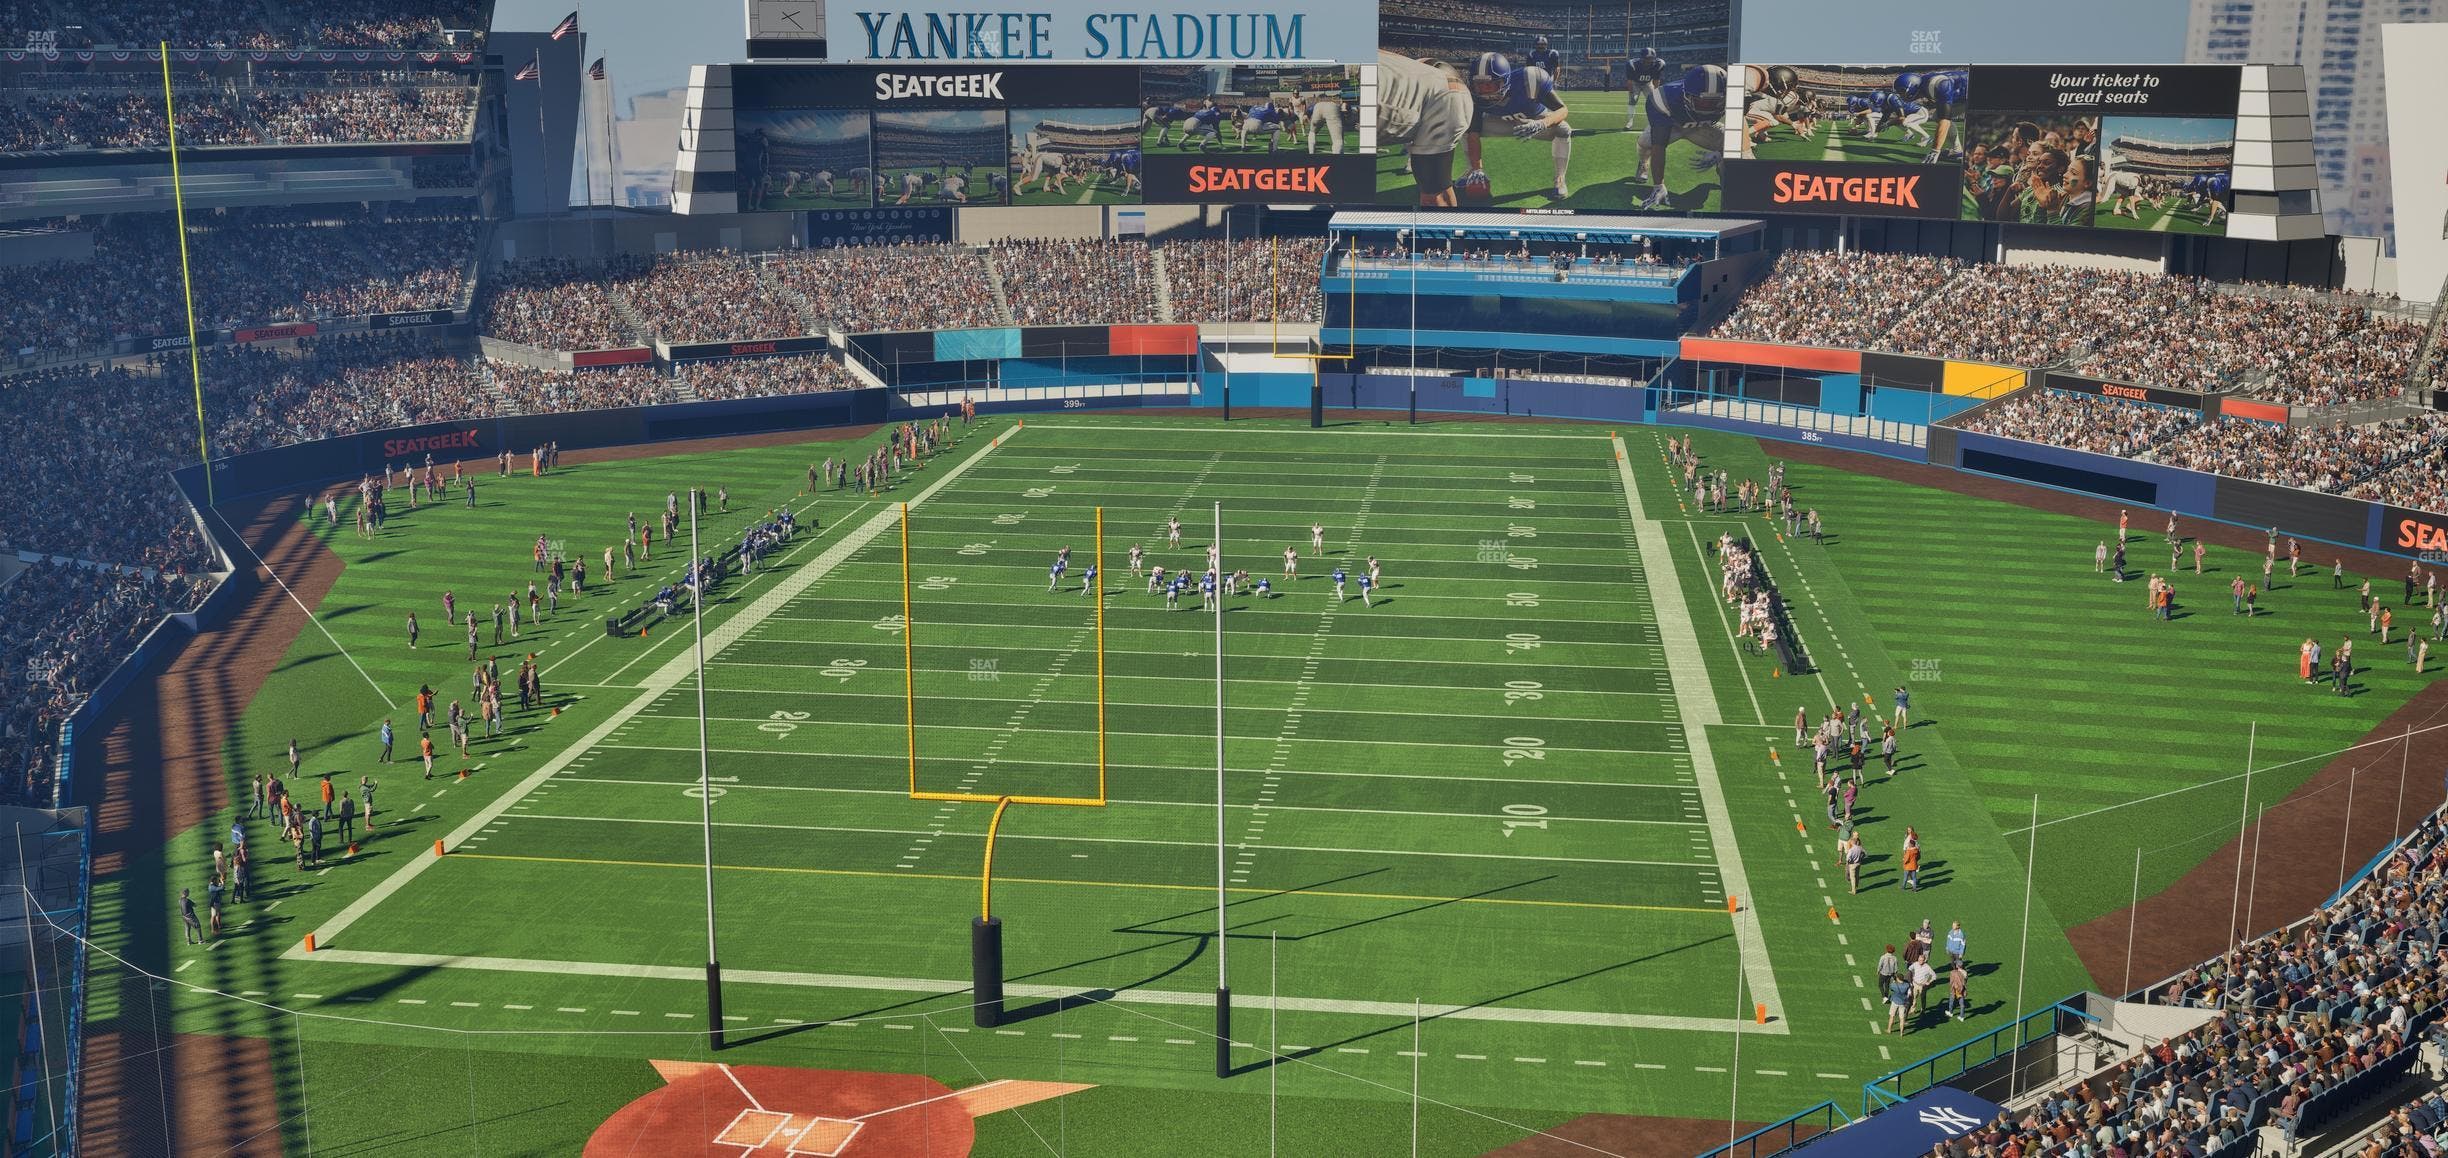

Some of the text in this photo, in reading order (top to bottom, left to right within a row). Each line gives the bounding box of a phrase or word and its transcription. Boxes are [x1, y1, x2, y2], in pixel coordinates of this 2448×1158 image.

[856, 12, 1307, 60] YANKEE STADIUM
[875, 72, 1005, 101] SEATGEEK
[2050, 73, 2160, 88] Your ticket to
[2058, 90, 2149, 106] great seats
[1189, 165, 1331, 195] SEATGEEK
[1773, 171, 1921, 209] SEATGEEK
[388, 313, 433, 326] SEATGEEK
[254, 326, 298, 340] SEATGEEK
[731, 342, 777, 354] SEATGEEK
[2102, 383, 2148, 401] SEATGEEK
[384, 428, 480, 458] SEATGEEK
[1507, 557, 1538, 570] 40
[1506, 592, 1539, 607] 50
[1505, 633, 1541, 650] 40
[820, 658, 868, 677] 30
[1504, 680, 1544, 700] 30
[757, 710, 811, 732] 20
[1503, 736, 1546, 760] 20
[682, 775, 740, 798] 10
[1501, 804, 1548, 829] 10
